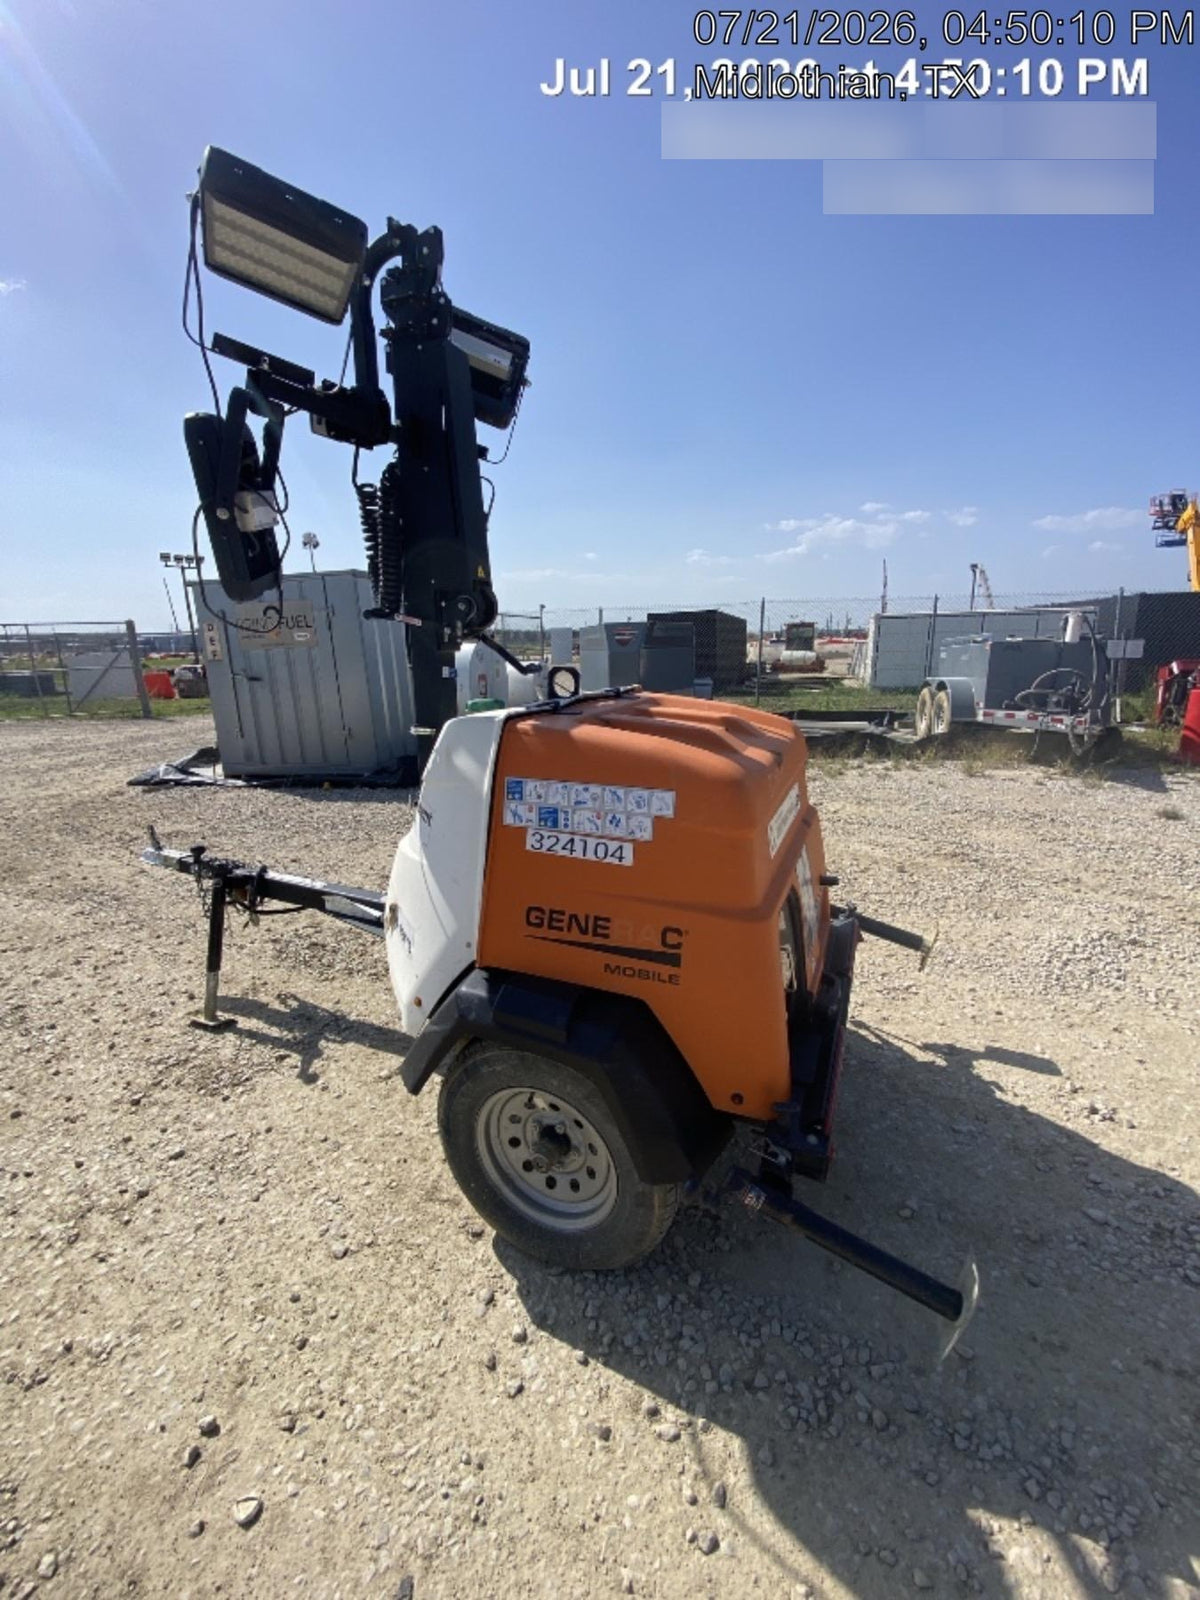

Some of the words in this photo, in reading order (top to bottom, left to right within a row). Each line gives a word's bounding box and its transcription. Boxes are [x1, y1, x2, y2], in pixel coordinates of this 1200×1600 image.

[278, 614, 313, 630] FUEL
[530, 831, 626, 863] 324104
[603, 963, 681, 986] MOBILE
